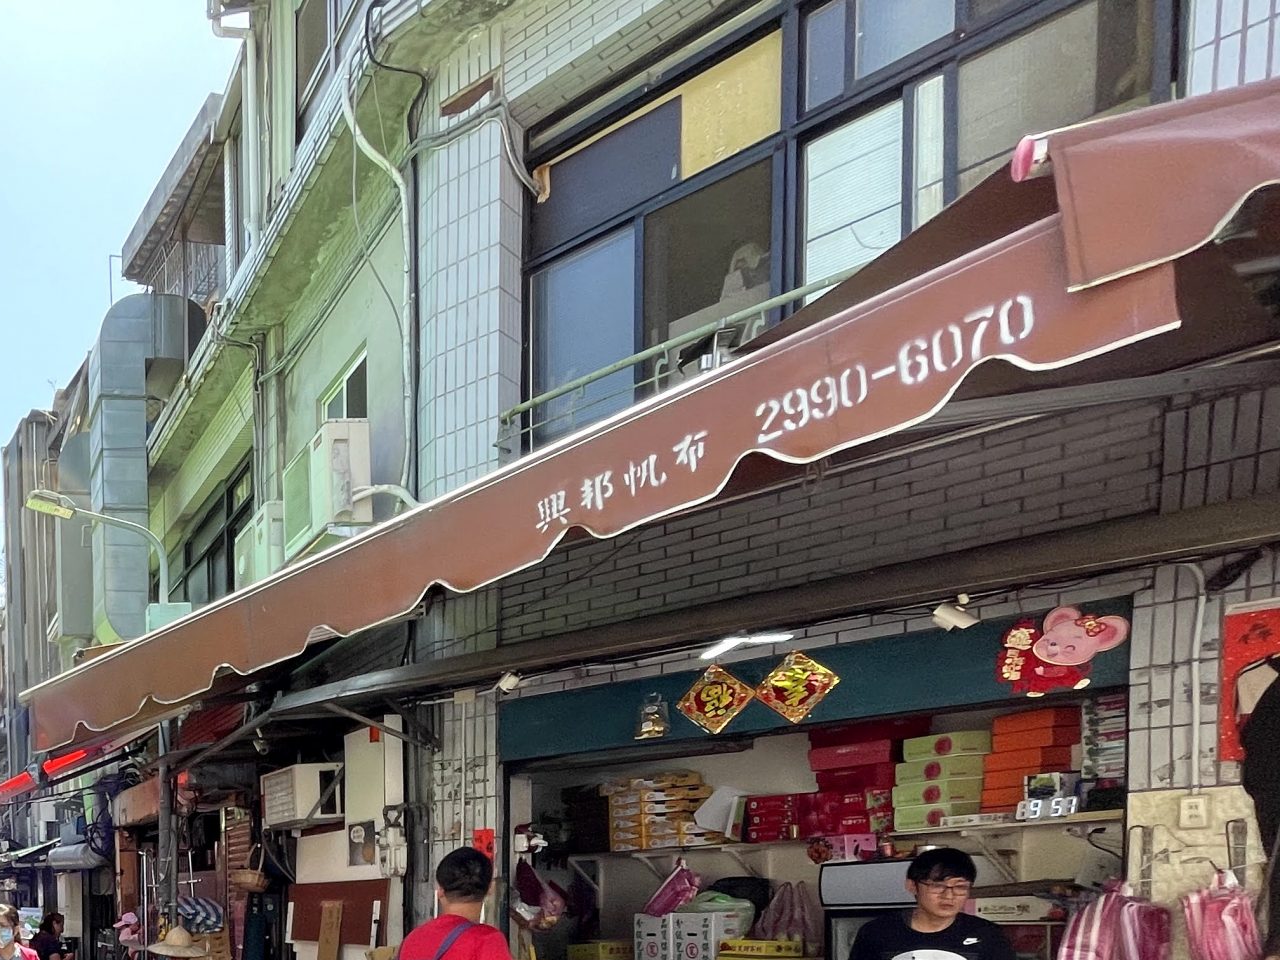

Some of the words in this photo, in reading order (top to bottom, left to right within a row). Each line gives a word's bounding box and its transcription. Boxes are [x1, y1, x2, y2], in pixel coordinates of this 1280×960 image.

[535, 430, 709, 533] 興邦帆布
[755, 295, 1036, 444] 2990-6070
